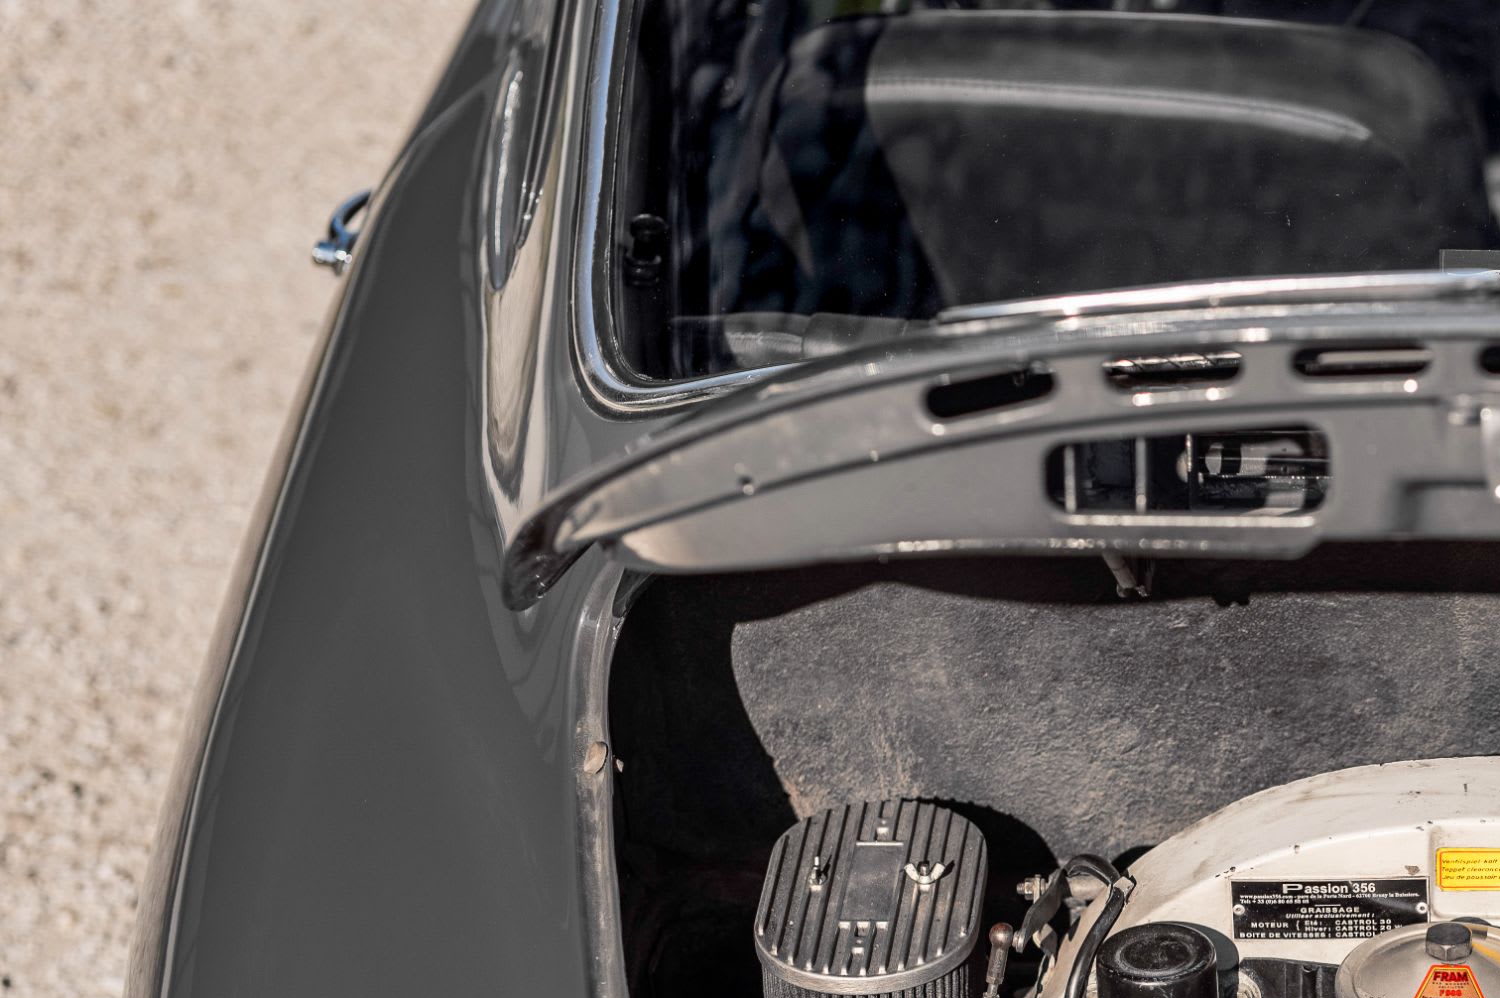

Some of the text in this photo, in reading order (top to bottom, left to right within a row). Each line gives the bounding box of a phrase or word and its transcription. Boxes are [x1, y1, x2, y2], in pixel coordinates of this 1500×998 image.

[1282, 882, 1376, 894] Passion 356
[1433, 971, 1469, 982] FRAM
